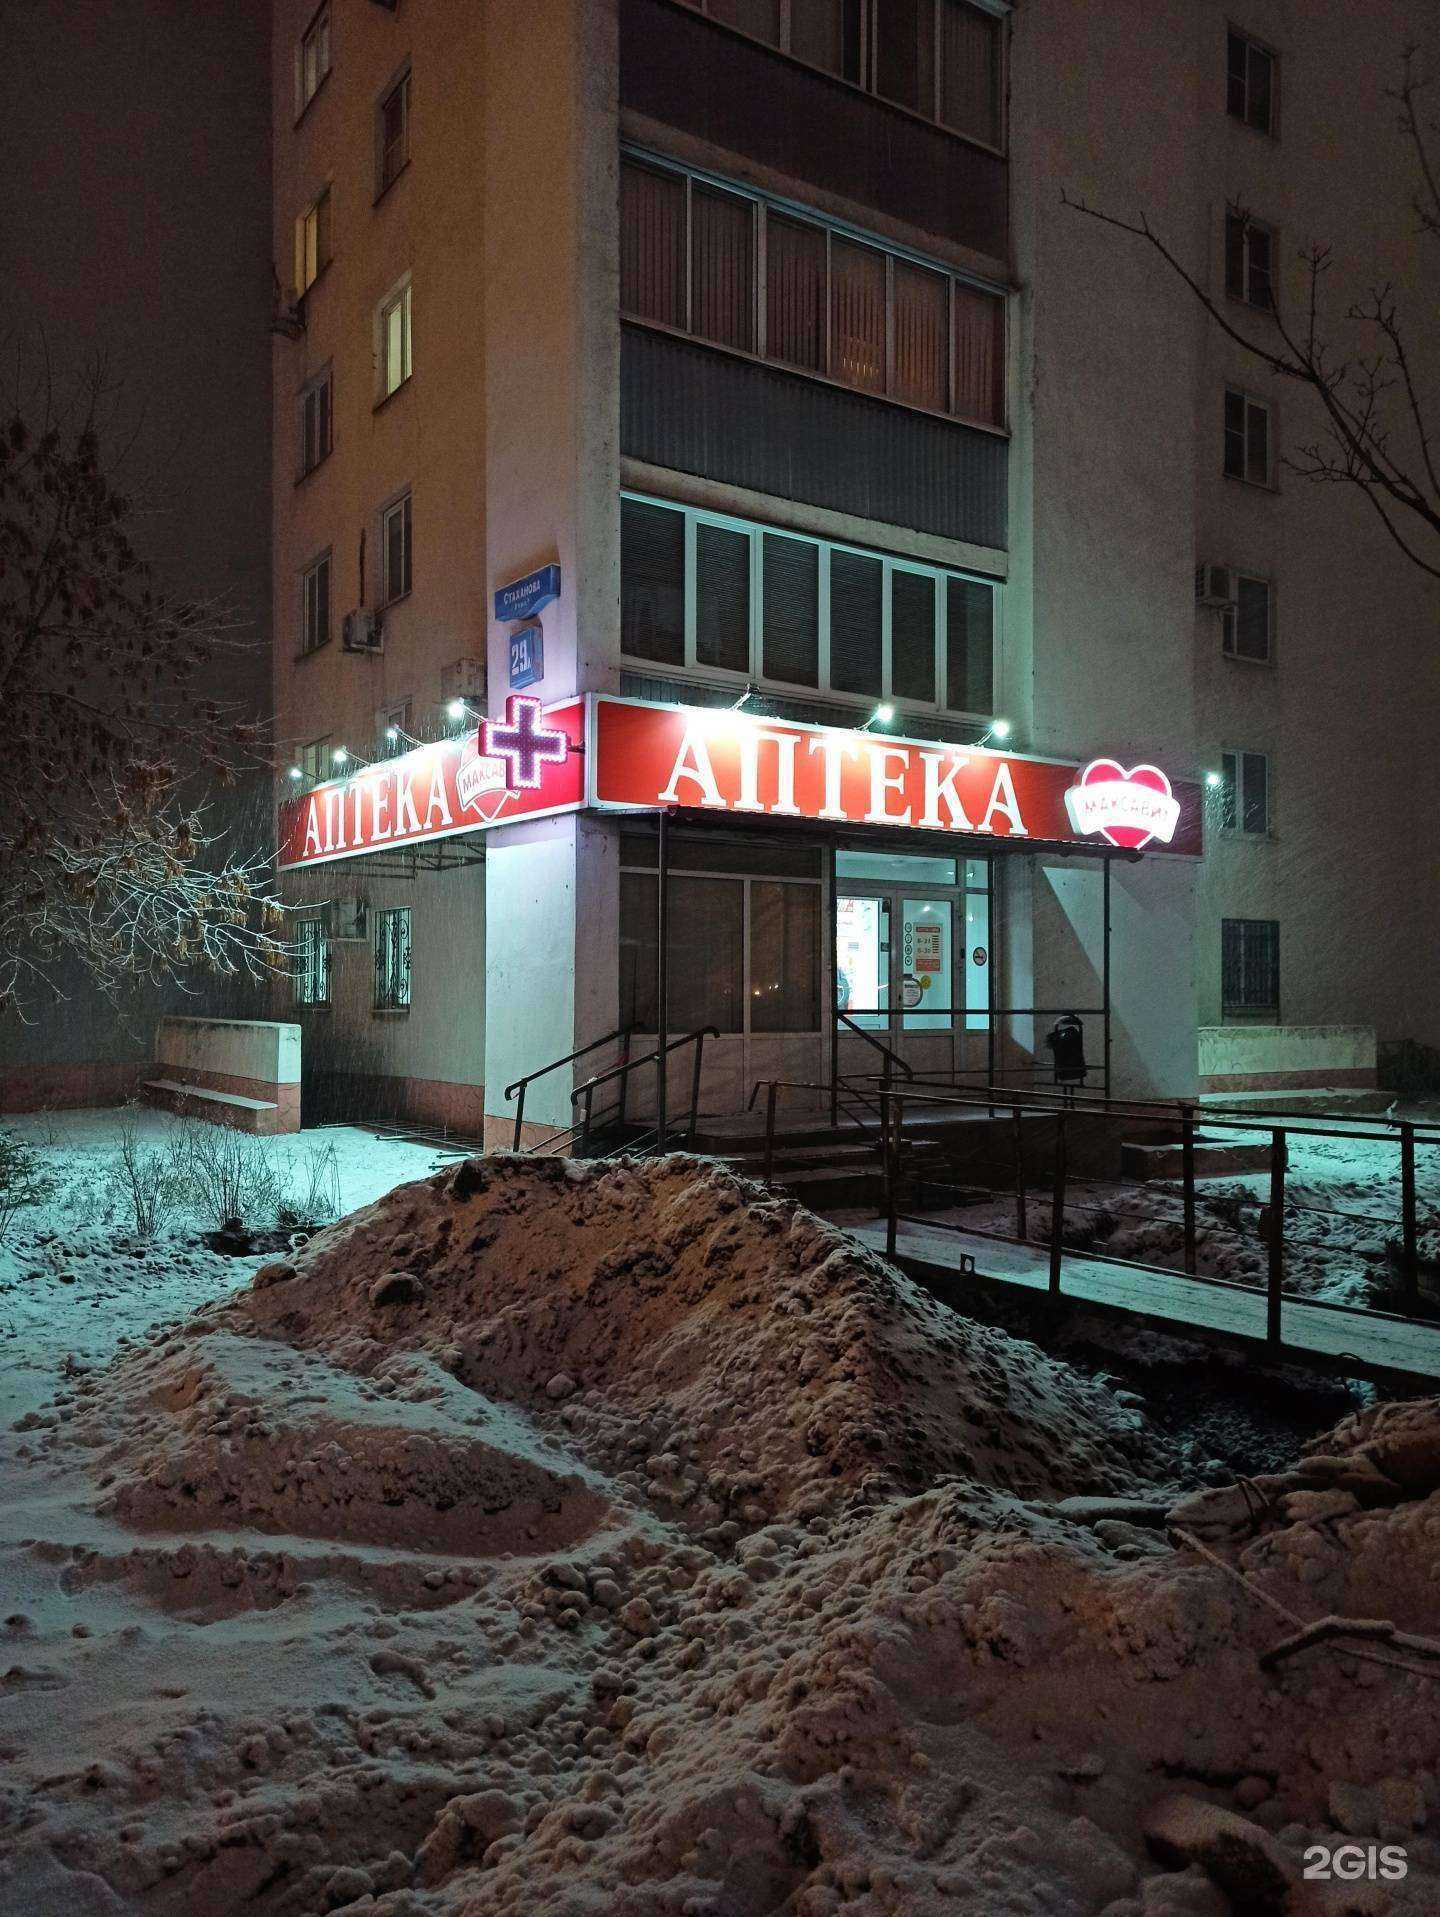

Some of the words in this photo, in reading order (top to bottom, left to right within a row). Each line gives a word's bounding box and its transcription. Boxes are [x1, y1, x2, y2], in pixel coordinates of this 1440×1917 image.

[302, 746, 453, 857] АПТЕКА
[463, 760, 506, 794] МАКСАВ
[657, 722, 1028, 836] АПТЕКА
